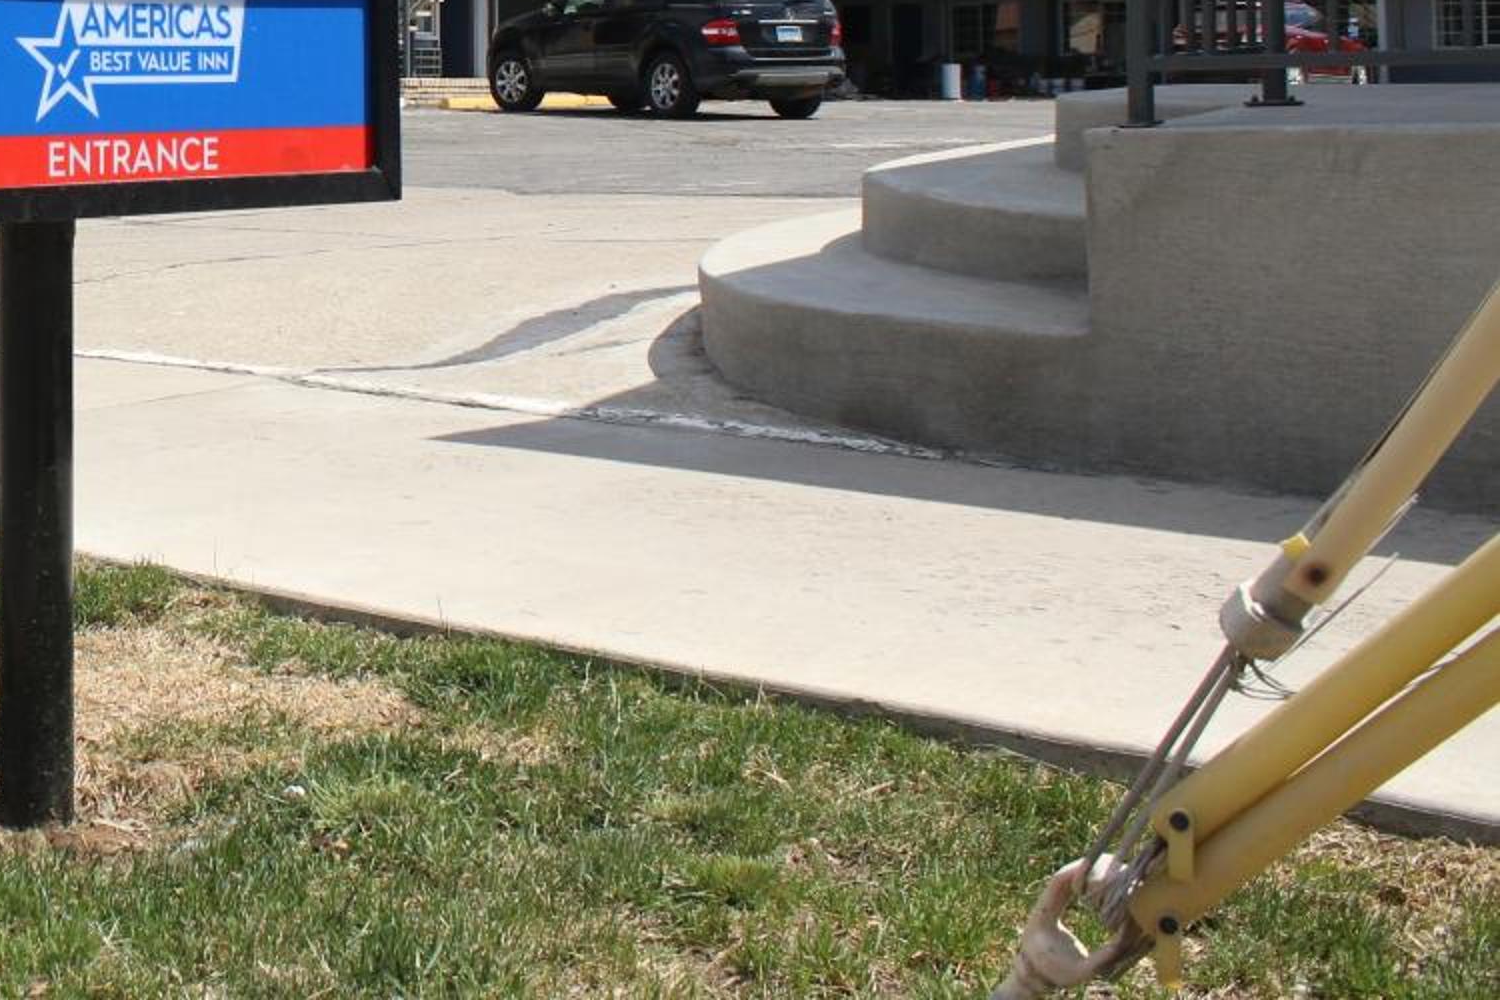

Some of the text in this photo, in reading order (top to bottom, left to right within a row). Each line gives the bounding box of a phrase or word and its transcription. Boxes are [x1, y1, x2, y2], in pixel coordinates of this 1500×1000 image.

[81, 0, 232, 39] AMERICAS
[90, 51, 228, 72] BEST VALUE INN
[48, 137, 219, 178] ENTRANCE
